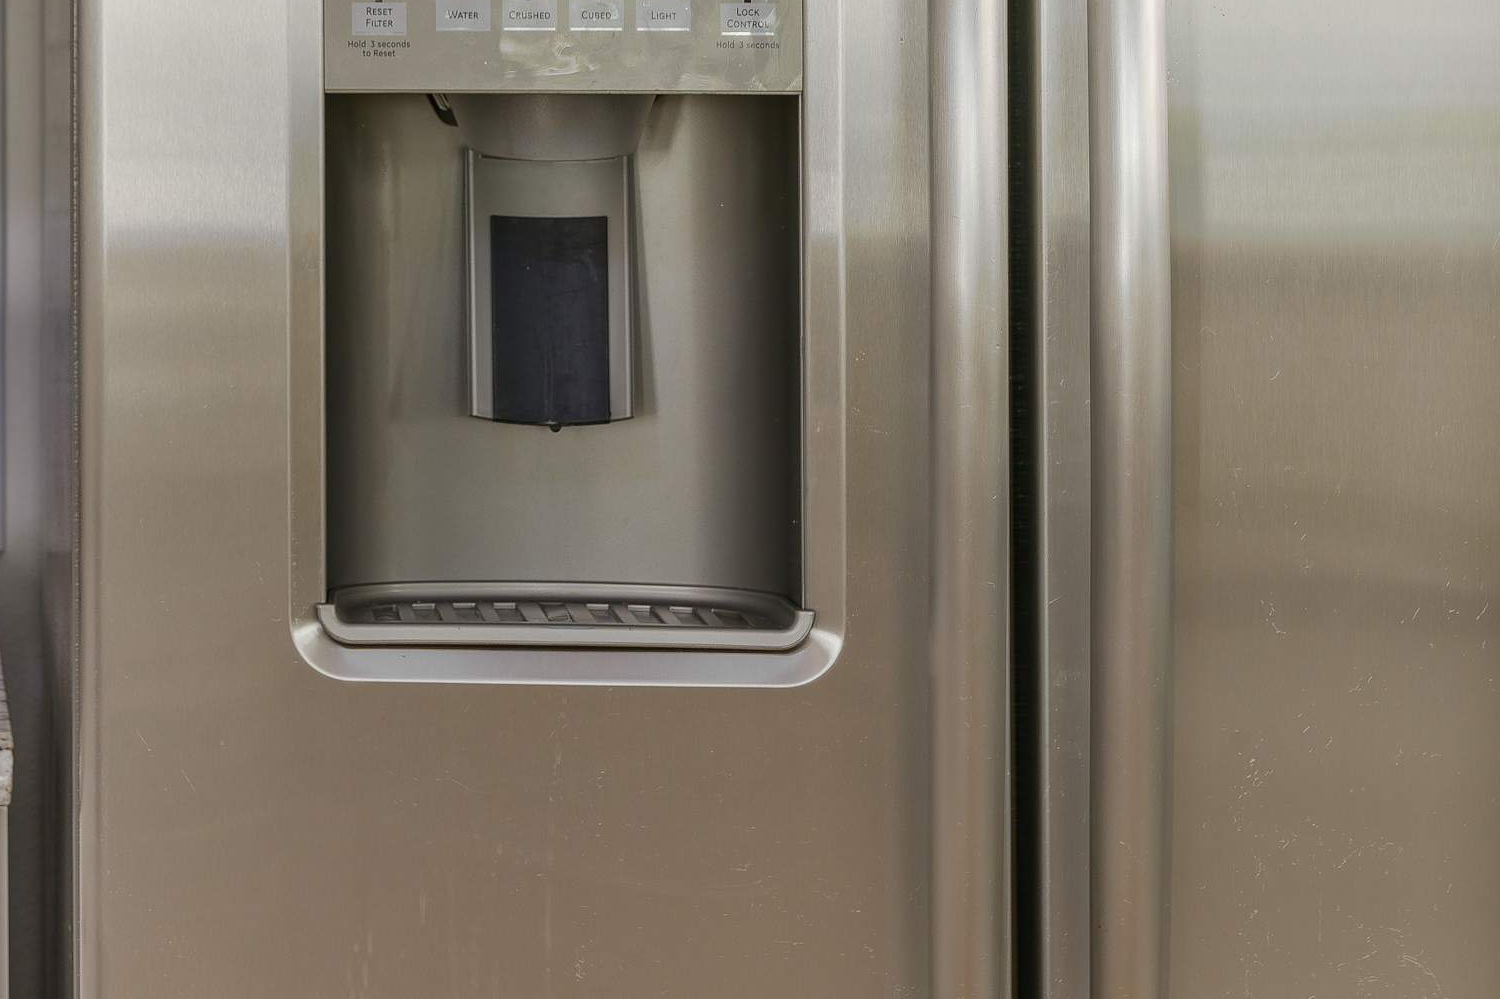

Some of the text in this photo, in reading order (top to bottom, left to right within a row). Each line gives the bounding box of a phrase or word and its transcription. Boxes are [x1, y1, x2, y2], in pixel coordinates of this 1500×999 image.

[366, 6, 393, 16] RESET
[448, 9, 479, 20] WATER
[508, 10, 551, 20] CRUSHED
[581, 10, 612, 20] CUBED
[651, 10, 677, 20] LIGHT
[736, 7, 760, 17] LOCK
[365, 18, 393, 28] FILTER
[726, 18, 769, 29] CONTROL
[347, 40, 366, 48] Hold
[377, 40, 411, 48] seconds
[716, 40, 735, 49] Hold
